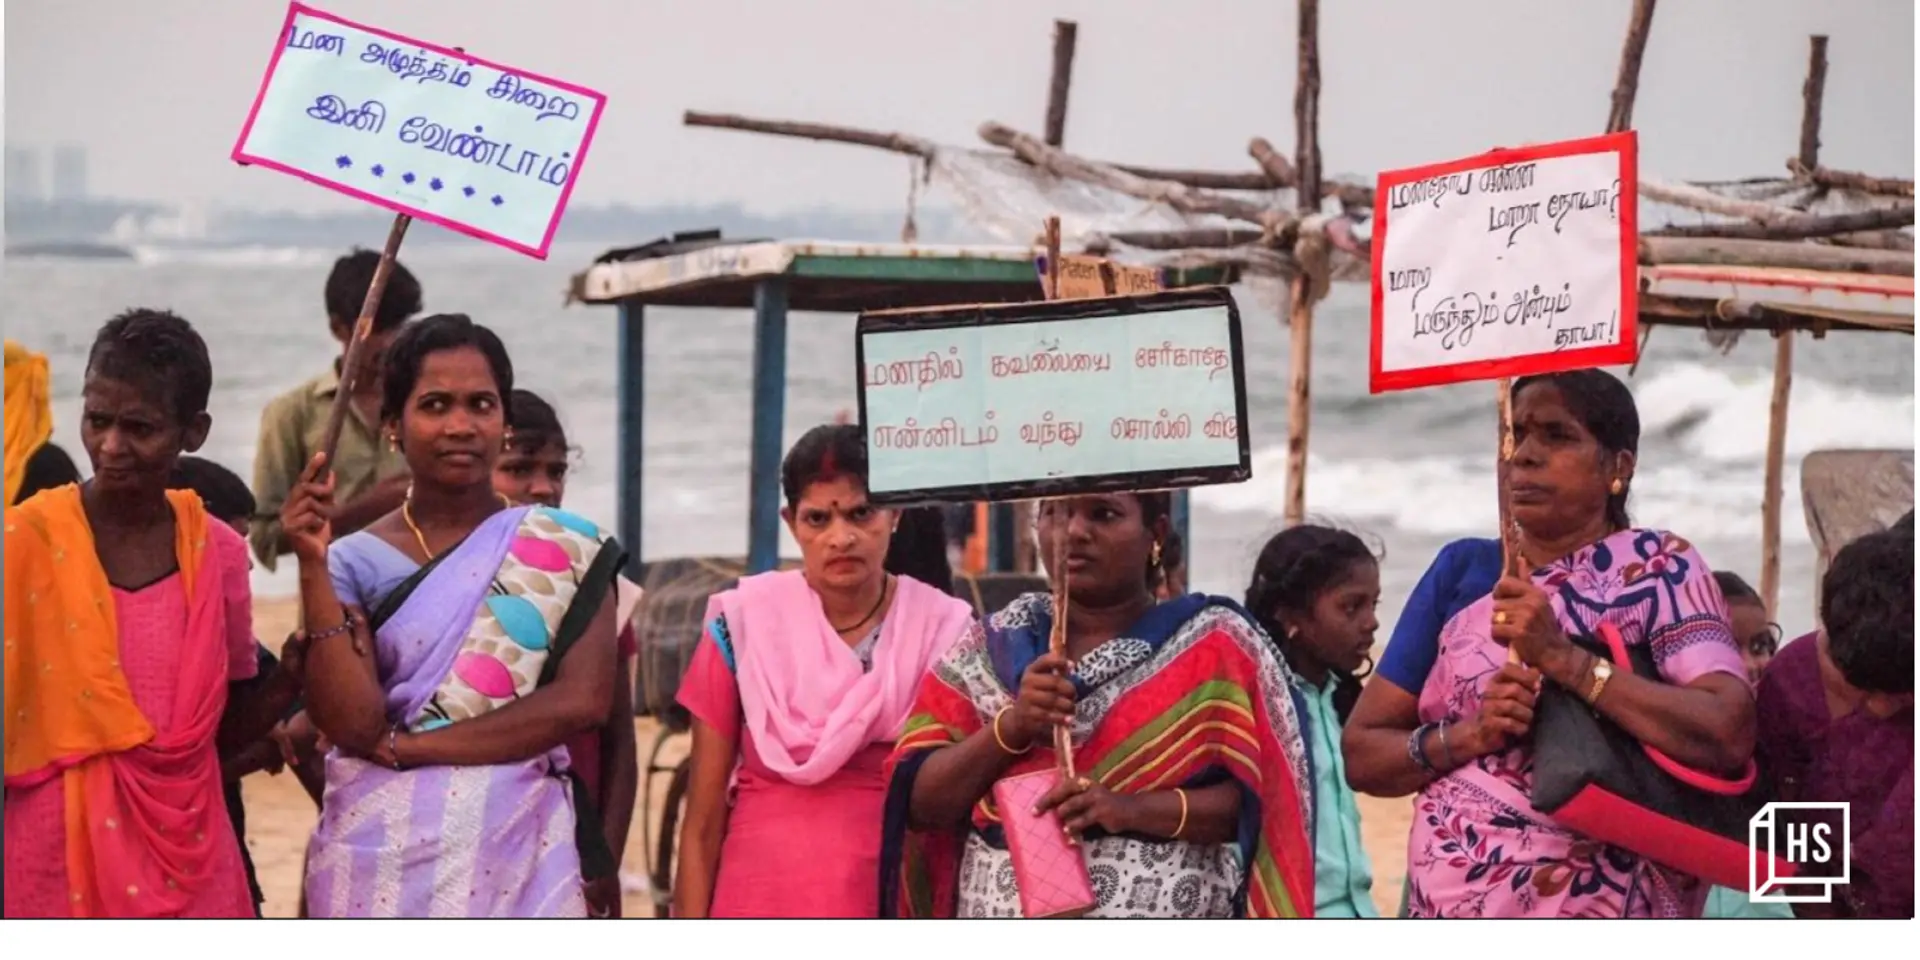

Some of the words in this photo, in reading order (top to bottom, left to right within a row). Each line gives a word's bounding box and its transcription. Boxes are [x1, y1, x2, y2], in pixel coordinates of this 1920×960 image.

[306, 94, 386, 134] இனி
[399, 116, 570, 186] வேண்டாம்
[1504, 282, 1571, 329] அன்பும்
[865, 346, 963, 392] மனதில்
[874, 410, 999, 449] என்னிடம்
[1020, 410, 1083, 452] வந்து
[1110, 408, 1192, 440] சொல்லி
